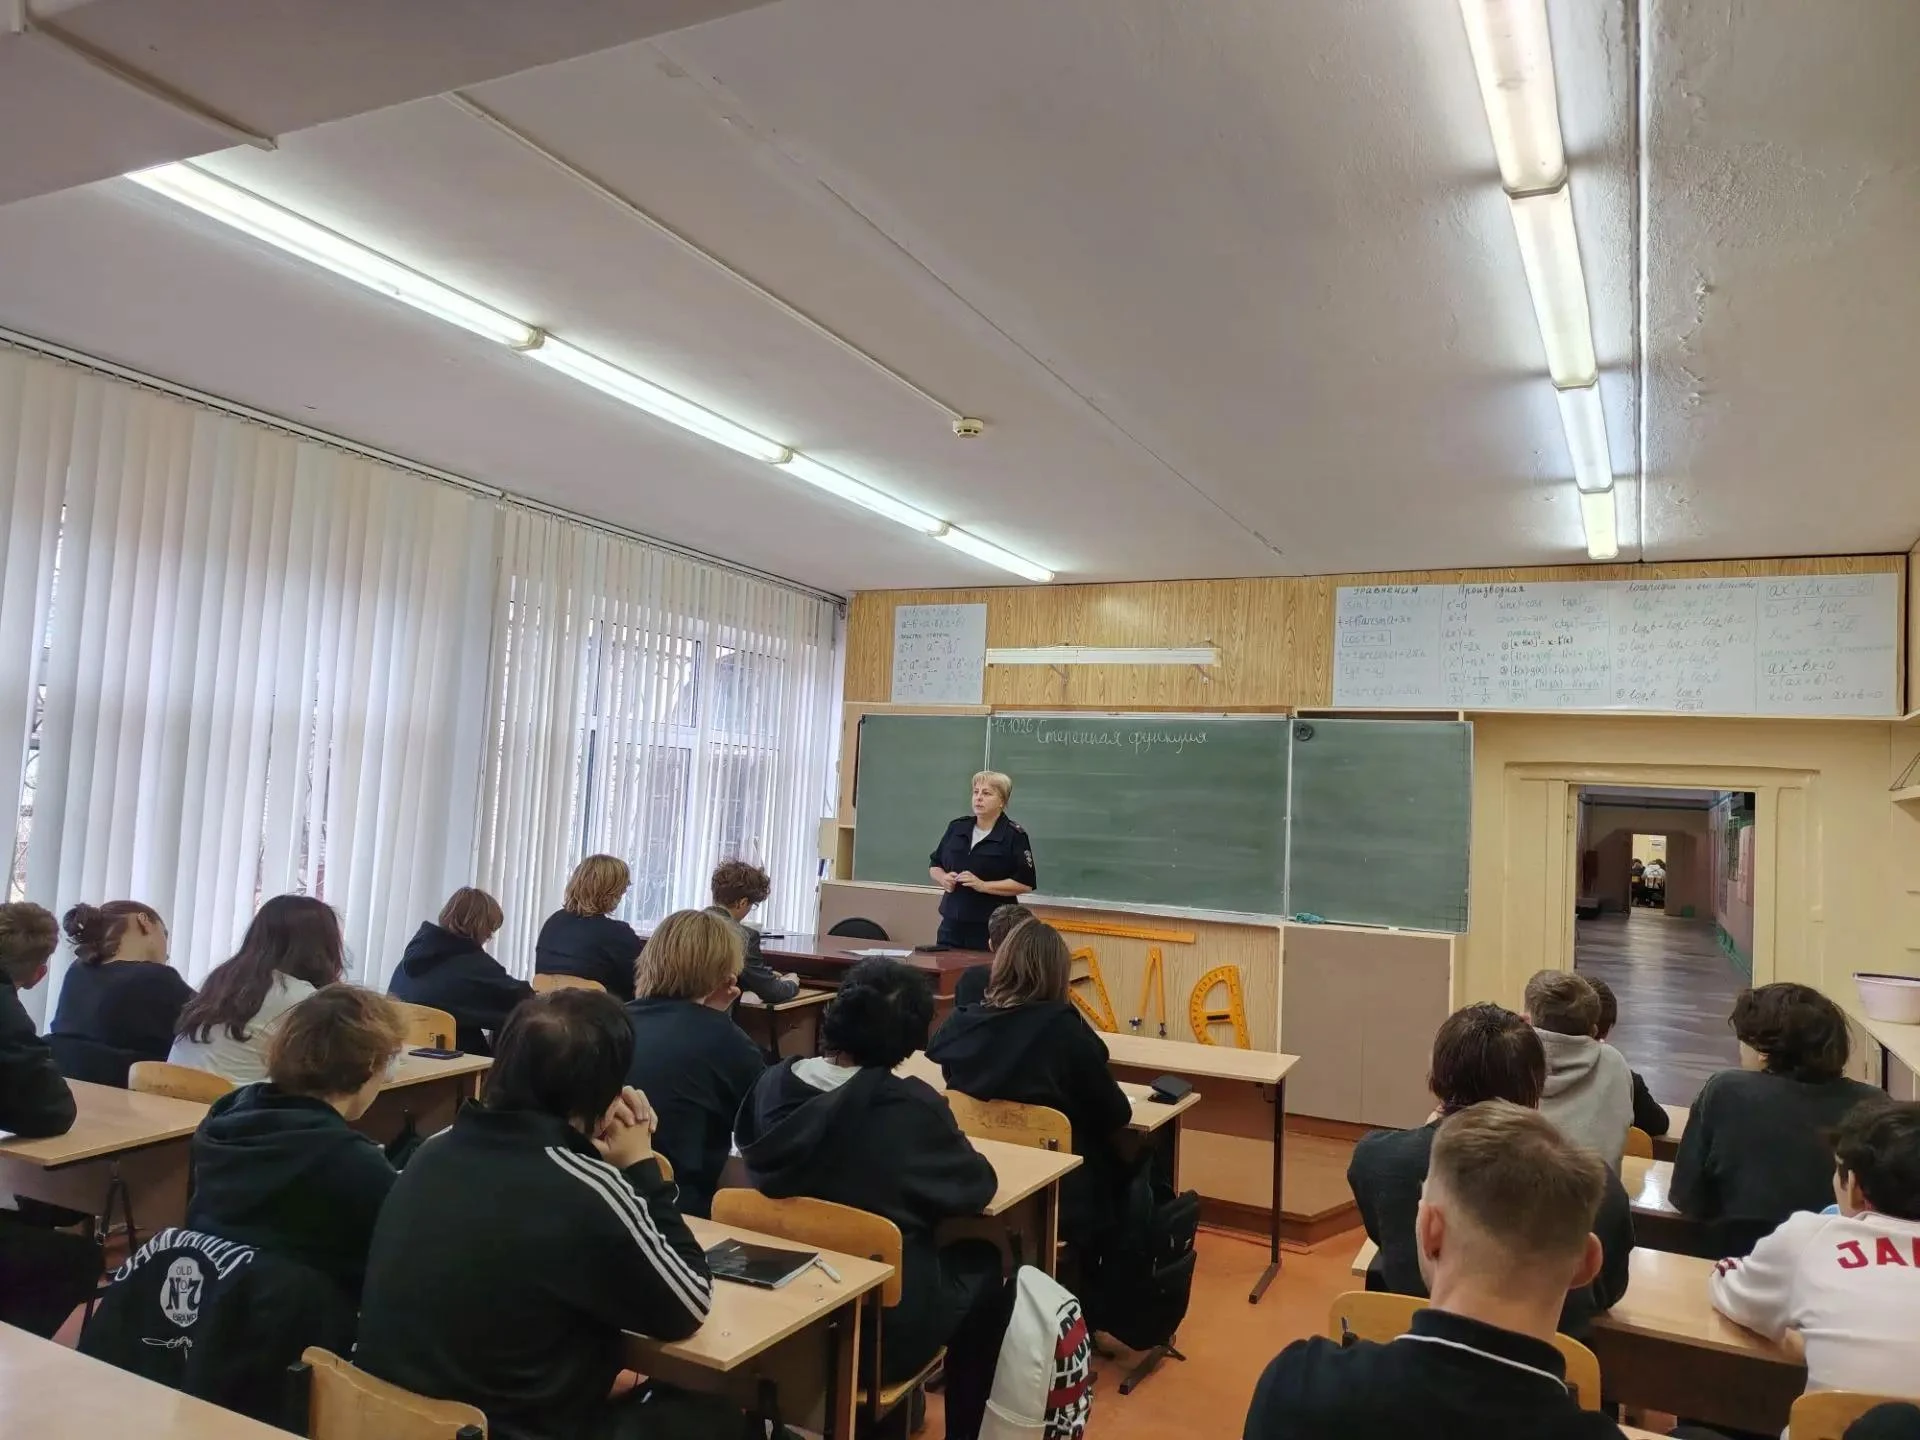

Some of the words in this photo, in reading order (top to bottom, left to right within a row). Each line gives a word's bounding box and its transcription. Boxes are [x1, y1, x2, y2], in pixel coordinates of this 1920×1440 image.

[1037, 719, 1122, 746] Степенная
[1128, 730, 1207, 755] функция
[175, 1265, 193, 1277] OLD
